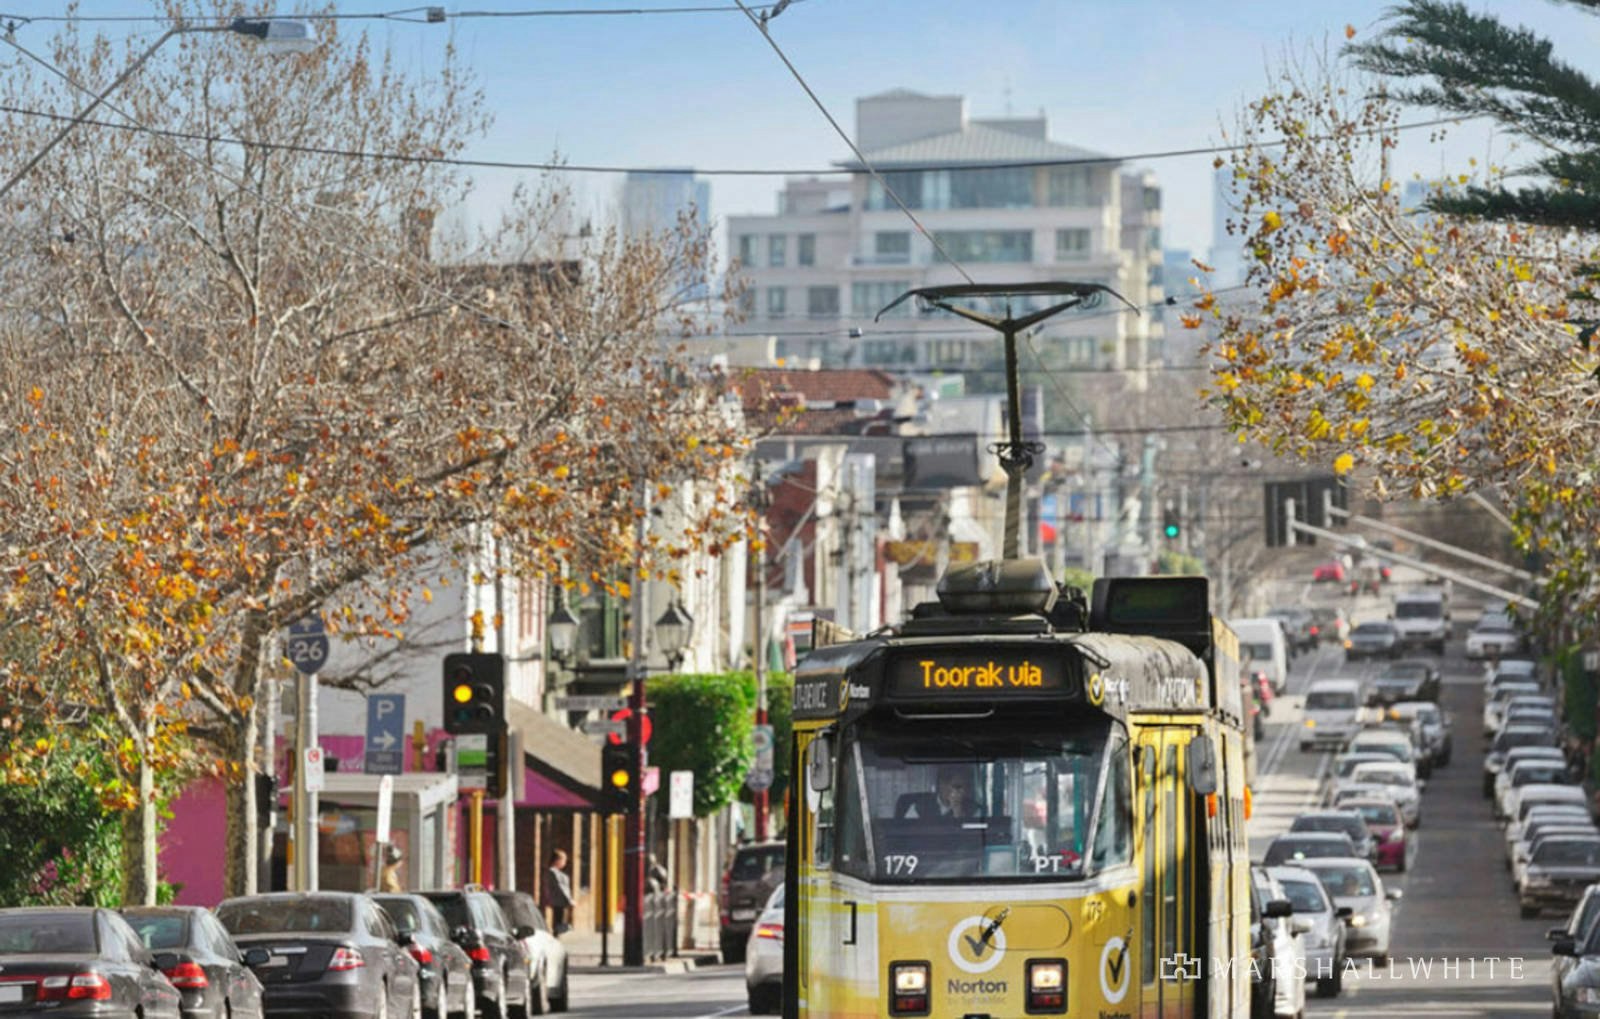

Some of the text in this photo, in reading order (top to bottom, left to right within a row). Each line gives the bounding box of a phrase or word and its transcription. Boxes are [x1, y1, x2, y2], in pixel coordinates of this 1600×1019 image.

[294, 640, 322, 662] 26
[920, 661, 1042, 687] Toorak via
[378, 699, 395, 720] P
[884, 855, 918, 875] 179
[948, 978, 1007, 994] Norton
